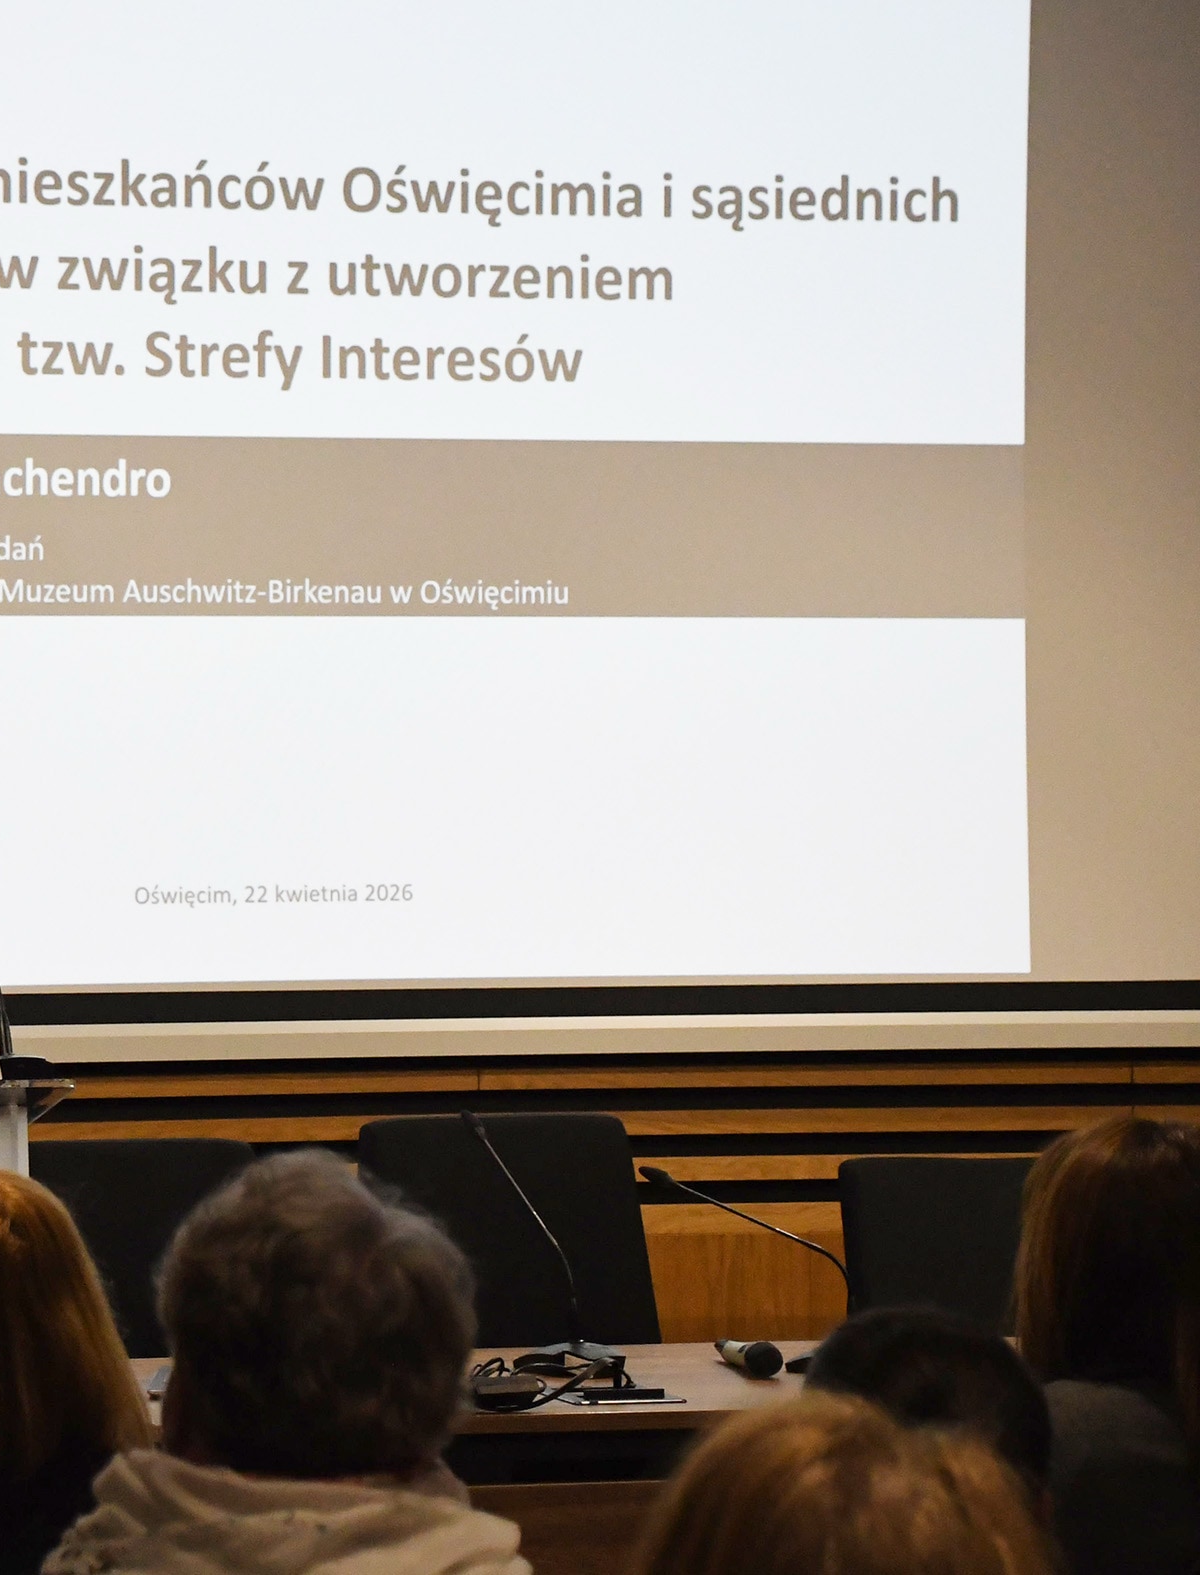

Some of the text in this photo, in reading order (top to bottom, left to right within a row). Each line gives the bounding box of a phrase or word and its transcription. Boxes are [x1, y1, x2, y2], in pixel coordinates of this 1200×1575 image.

[343, 165, 642, 227] Oświęcimia
[663, 172, 672, 218] i
[692, 174, 958, 232] sąsiednich
[58, 245, 267, 305] związku
[287, 261, 309, 294] z
[329, 254, 672, 300] utworzeniem
[17, 332, 124, 375] tzw.
[145, 330, 302, 391] Strefy
[323, 334, 582, 382] Interesów
[0, 579, 114, 602] Muzeum
[123, 578, 381, 603] Auschwitz-Birkenau
[390, 586, 412, 603] w
[421, 579, 568, 610] Oświęcimiu
[135, 884, 413, 908] Oświęcim, 22 kwietnia 2026
